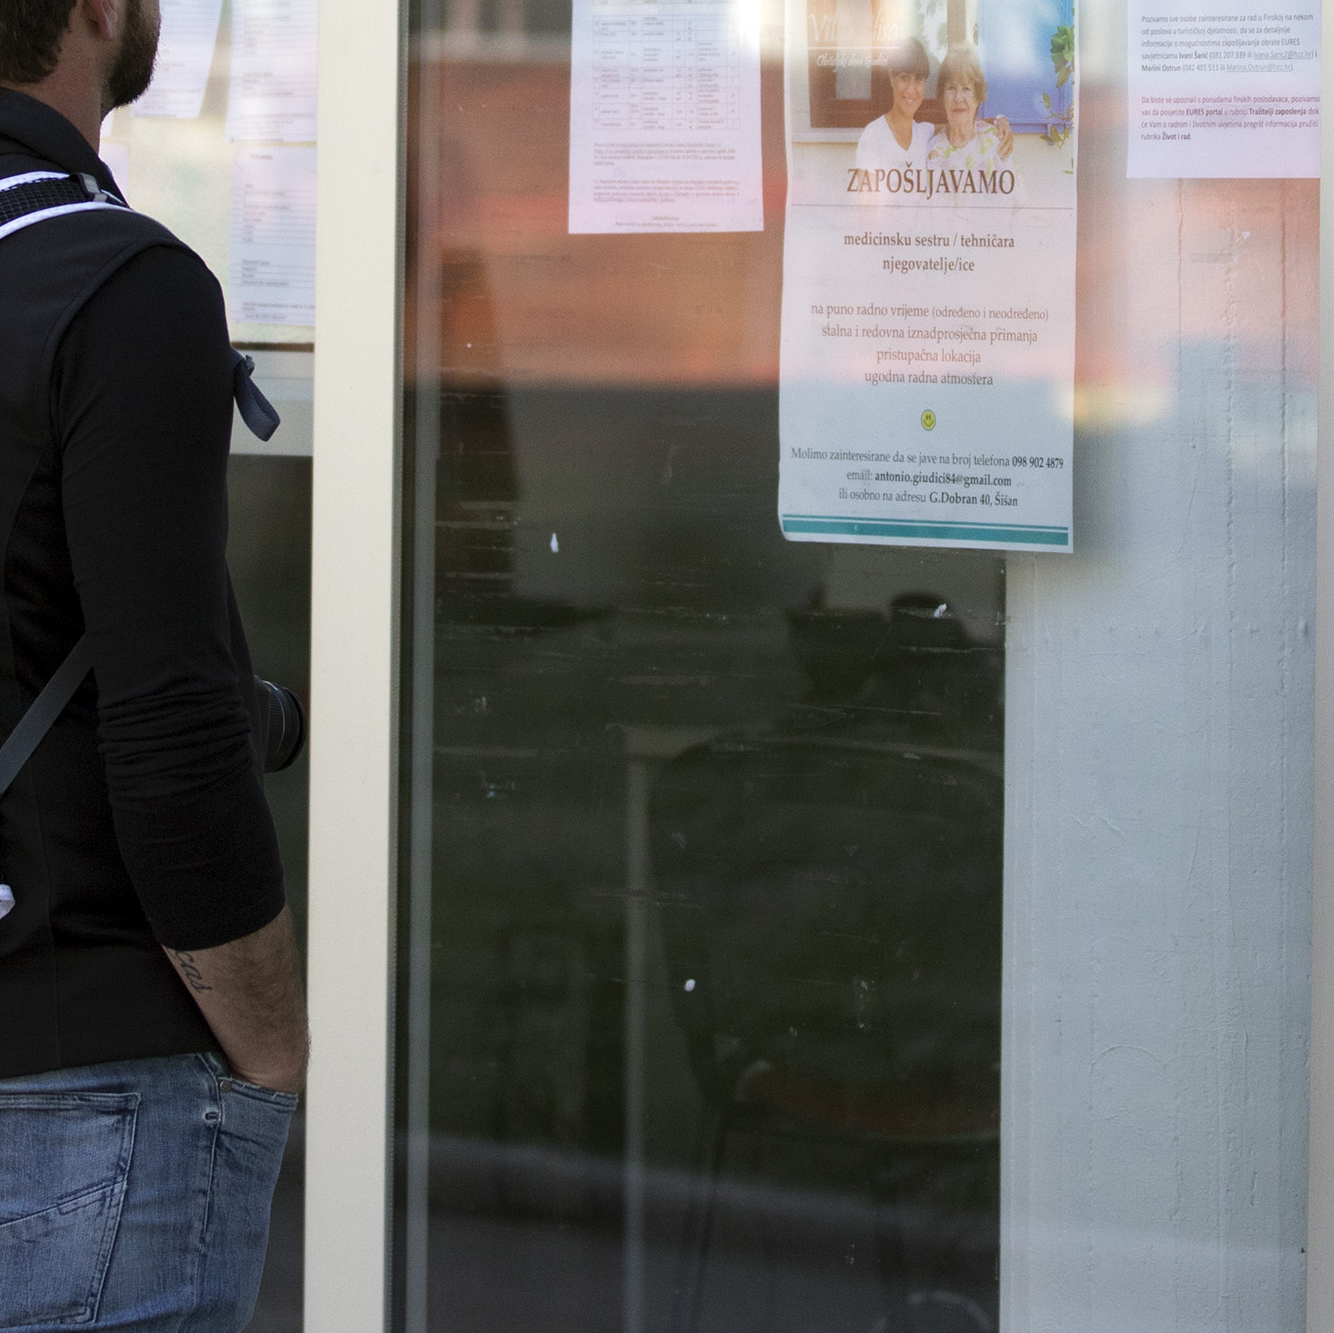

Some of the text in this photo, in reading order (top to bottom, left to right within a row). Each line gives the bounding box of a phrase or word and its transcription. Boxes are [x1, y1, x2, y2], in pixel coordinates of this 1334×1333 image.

[847, 162, 1015, 199] ZAPOŠLJAVAMO
[844, 231, 911, 246] medicinsku
[916, 234, 949, 247] sestru
[961, 233, 1015, 248] tehničara
[883, 257, 975, 274] njegovatelje/ice
[811, 305, 823, 314] na
[827, 305, 854, 319] puno
[857, 304, 888, 316] radno
[891, 305, 929, 320] vrijeme
[932, 306, 980, 319] (određeno
[989, 307, 1049, 322] neodređeno)
[822, 324, 852, 337] stalna
[862, 325, 904, 338] redovna
[908, 326, 986, 344] iznadprosječna
[990, 328, 1038, 345] primanja
[876, 348, 981, 366] pristupačna lokacija
[865, 371, 994, 386] ugodna radna atmosfera
[791, 447, 827, 460] Molimo
[829, 451, 890, 462] zainteresirane
[893, 451, 904, 463] da
[920, 451, 936, 465] jave
[940, 456, 949, 464] na
[953, 453, 970, 468] broj
[974, 454, 1009, 467] telefona
[1012, 456, 1027, 468] 098
[1029, 456, 1044, 468] 902
[846, 470, 1012, 488] email: antonio.giudici84@gmail.com
[839, 489, 848, 499] ili
[849, 488, 880, 500] osobno
[882, 493, 892, 501] na
[895, 490, 925, 503] adresu
[929, 491, 977, 504] G.Dobran
[995, 491, 1018, 506] Šišan
